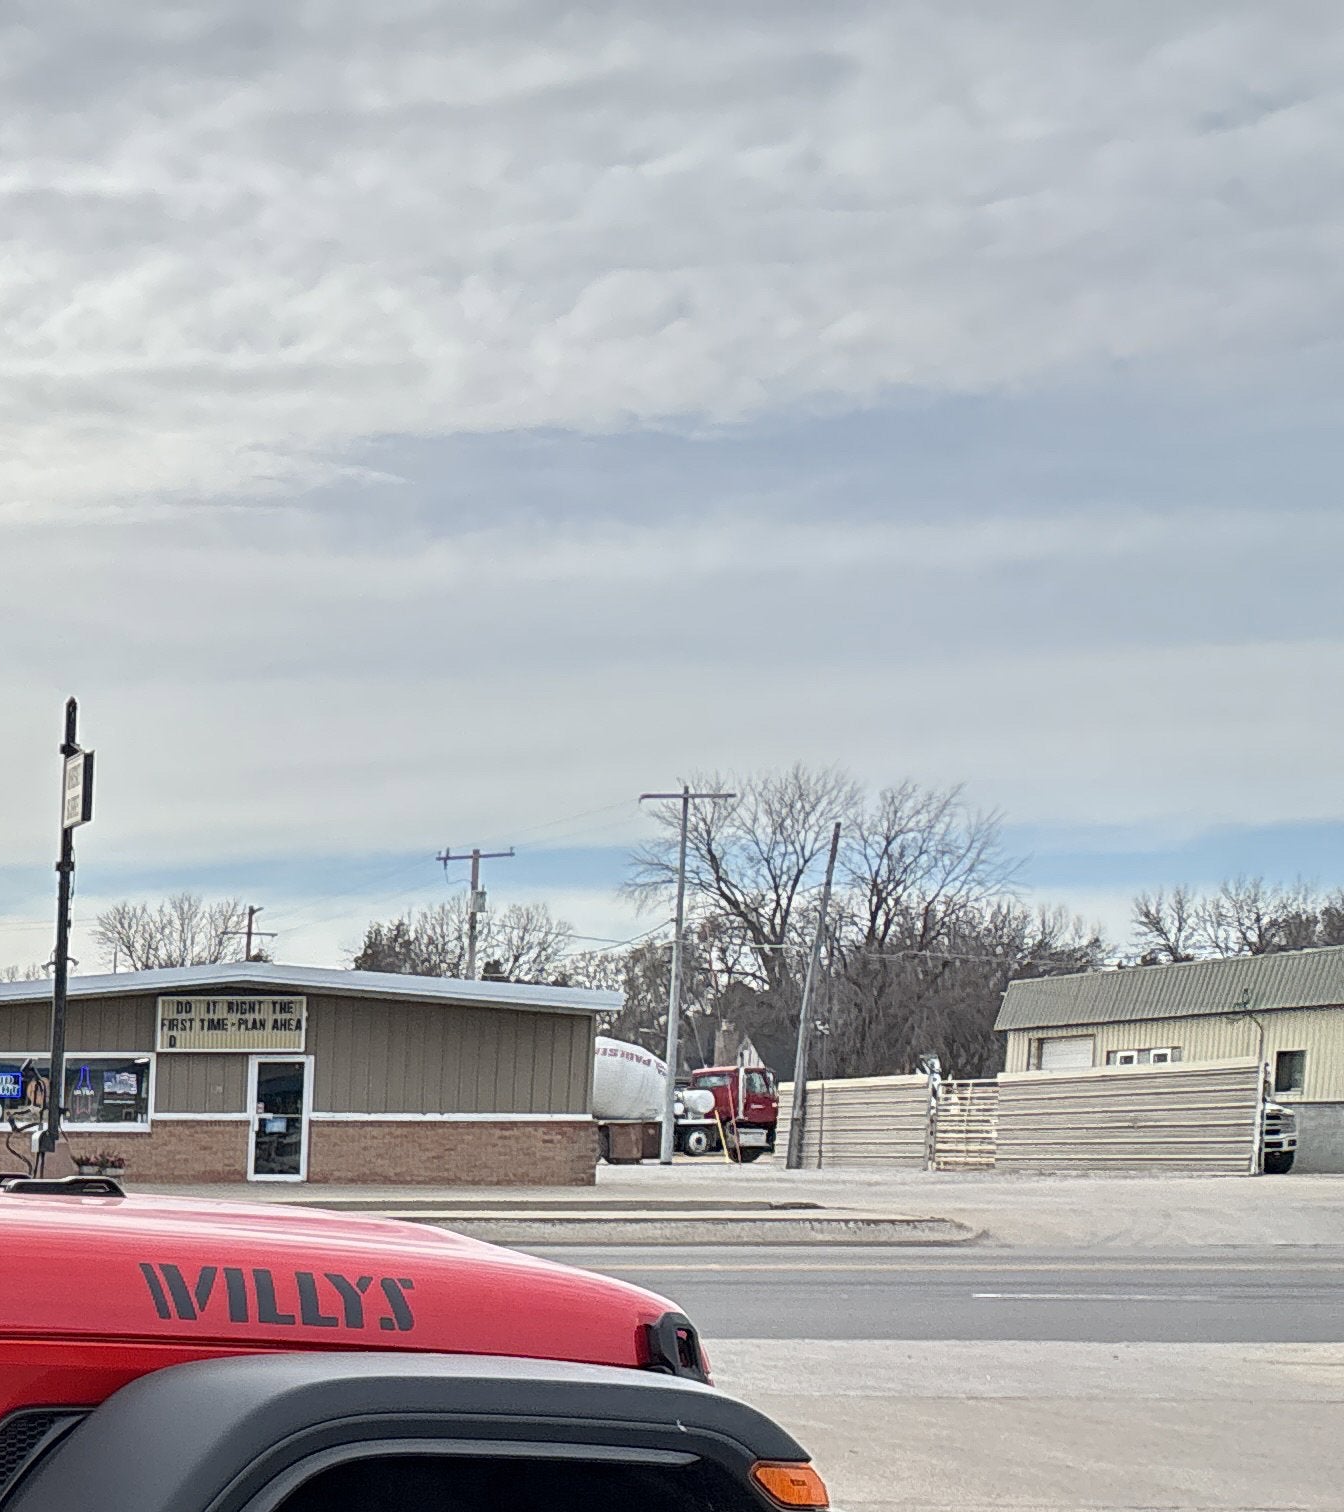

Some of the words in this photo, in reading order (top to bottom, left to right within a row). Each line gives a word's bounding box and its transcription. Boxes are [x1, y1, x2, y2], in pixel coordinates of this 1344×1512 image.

[175, 1001, 193, 1015] DO
[206, 1001, 218, 1015] IT
[227, 1000, 264, 1015] RIGHT
[271, 1000, 294, 1015] THE
[160, 1017, 194, 1032] FIRST
[271, 1017, 303, 1032] AHEA
[168, 1034, 177, 1049] D
[138, 1262, 415, 1332] WILLYS
